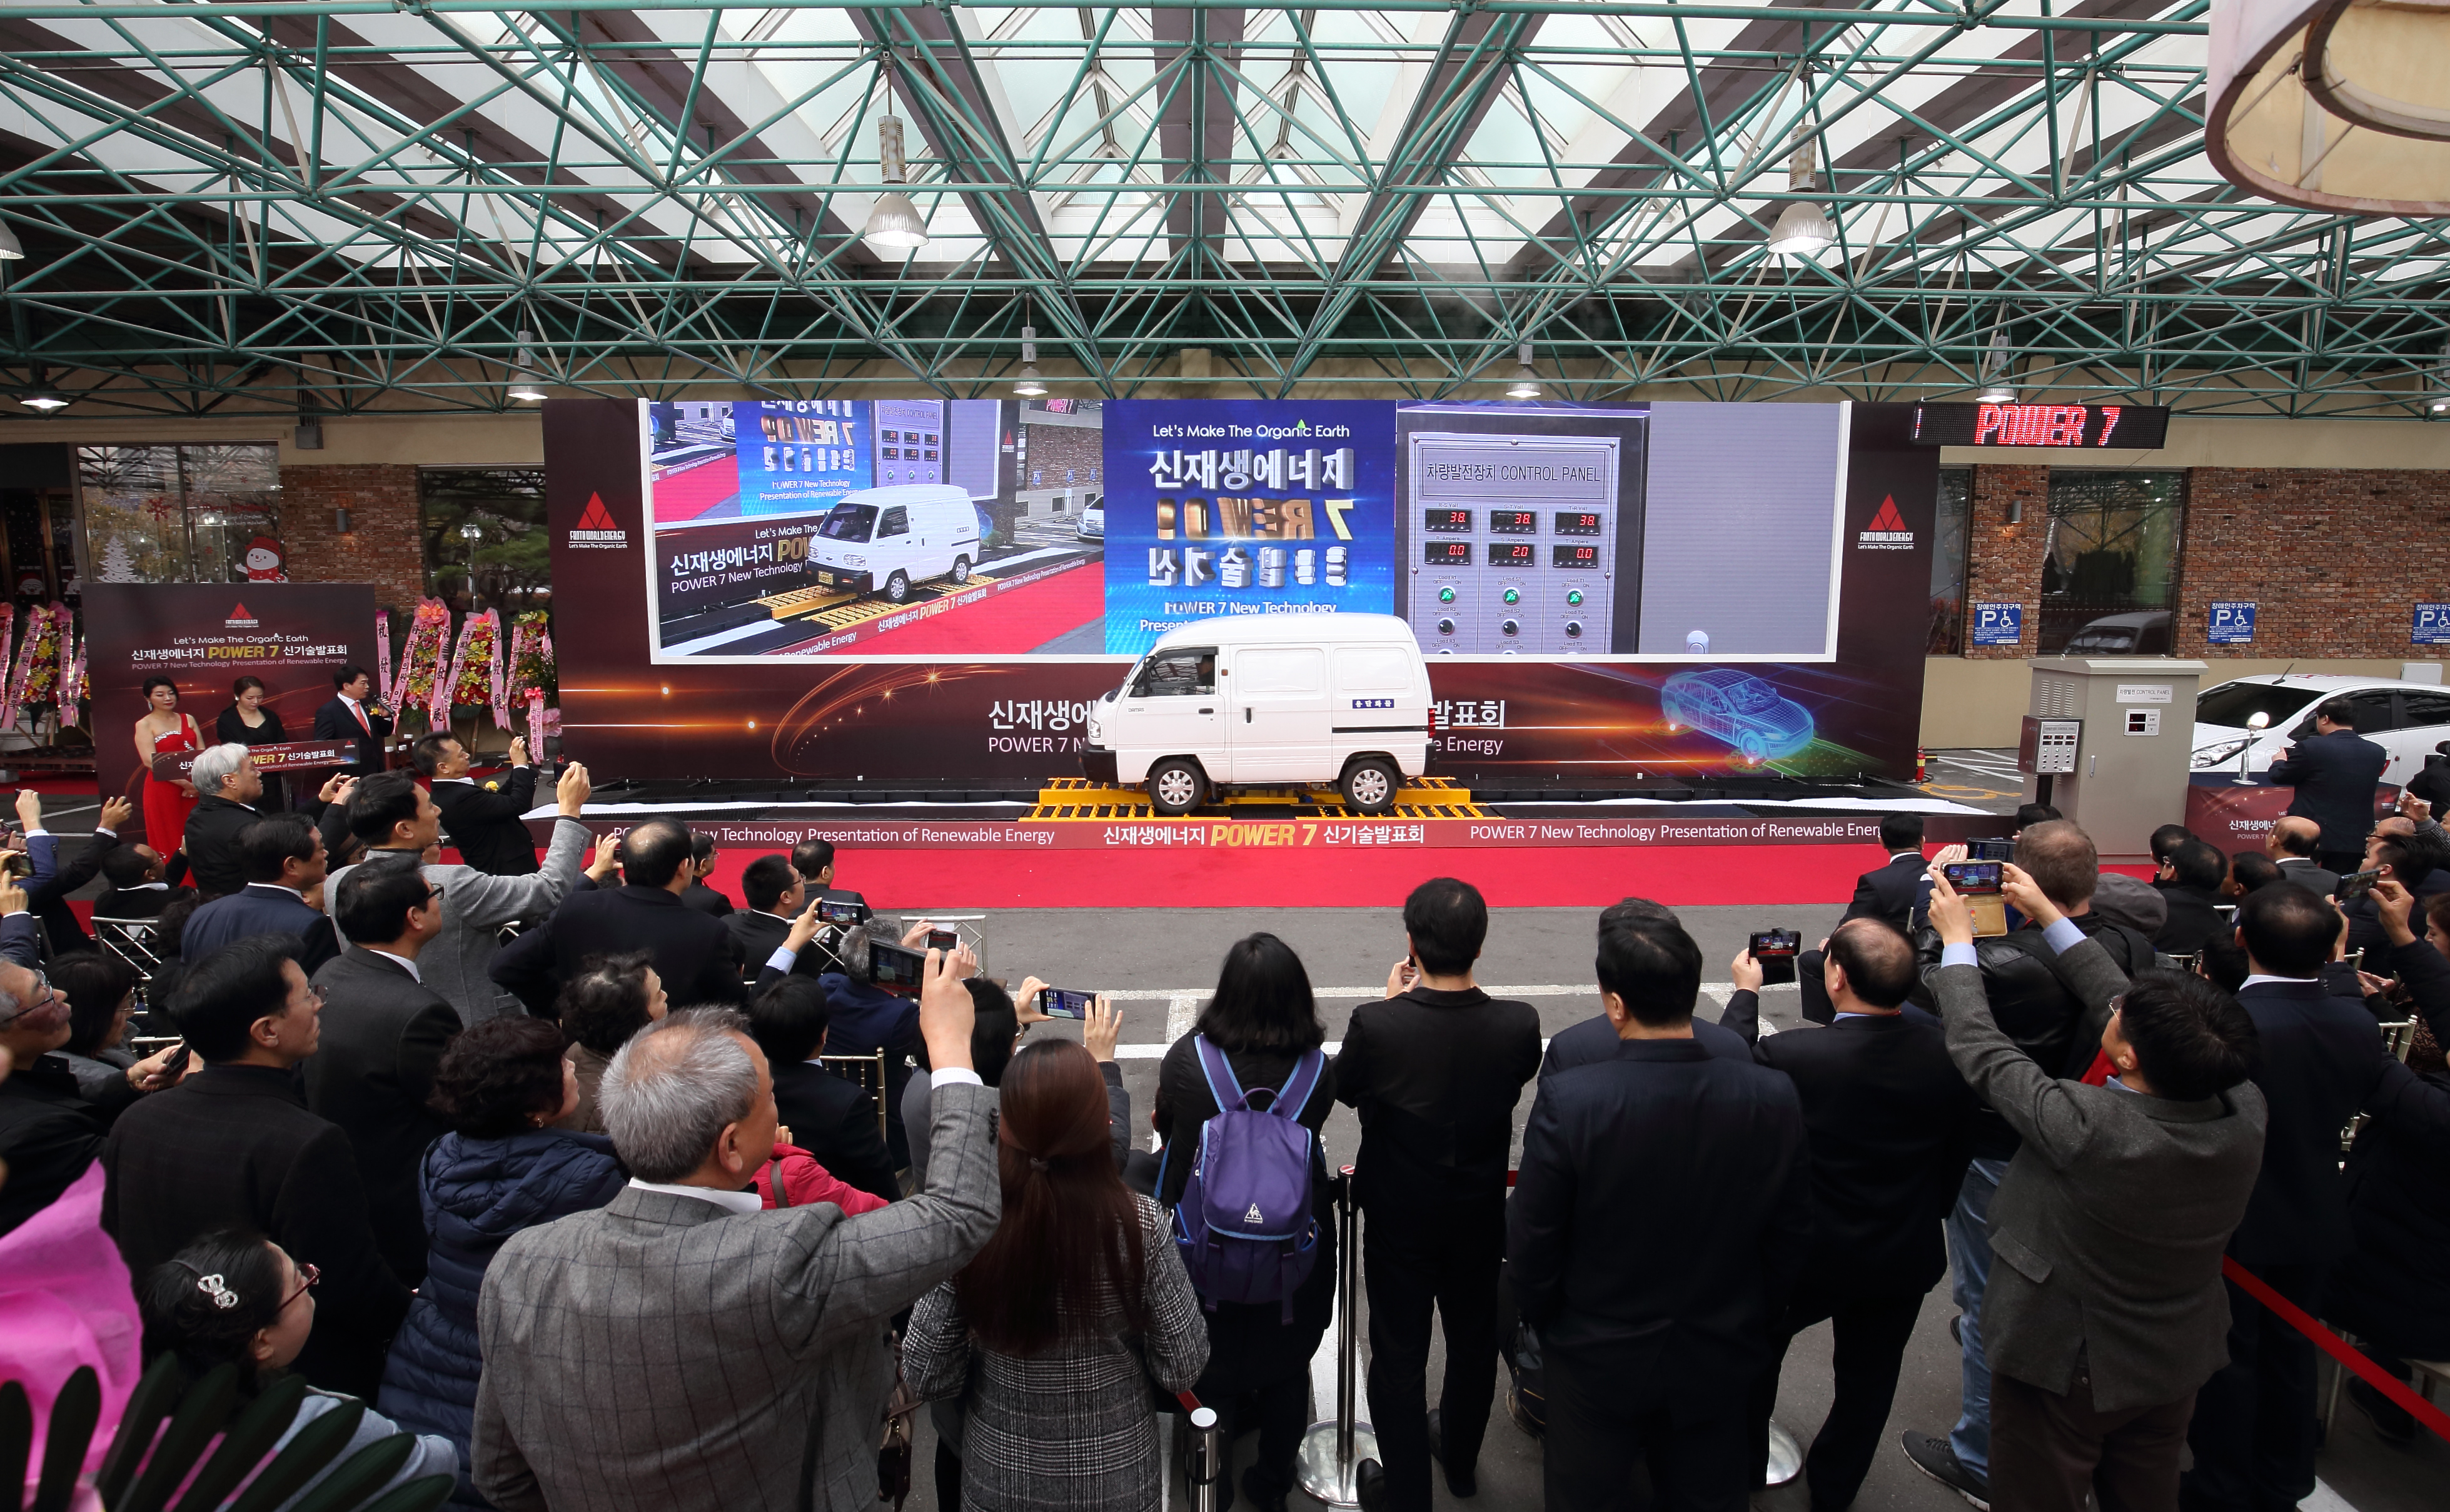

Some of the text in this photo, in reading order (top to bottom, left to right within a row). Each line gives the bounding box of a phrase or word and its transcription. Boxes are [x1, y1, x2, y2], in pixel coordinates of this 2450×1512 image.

[907, 408, 939, 420] CONTROL PANEL
[1153, 424, 1349, 440] Let's Make The Organic Earth
[1974, 404, 2121, 446] POWER 7
[1149, 448, 1354, 491] 신재생에너지
[1426, 463, 1601, 482] 차량발전장치 CONTROL PANEL
[819, 480, 850, 488] Technology
[760, 489, 842, 501] Presentation of Renewable
[755, 525, 818, 539] Let's Make The
[1513, 546, 1528, 557] 2.0
[670, 543, 773, 577] 신재생에너지
[672, 575, 717, 593] POWER
[718, 574, 726, 585] 7
[728, 570, 752, 583] New
[753, 561, 802, 578] Technology
[877, 609, 919, 632] 신재생에너지
[920, 598, 949, 620] POWER
[950, 597, 956, 610] 7
[1218, 602, 1227, 614] 7
[1229, 601, 1260, 614] New
[1263, 601, 1336, 614] Technology
[1981, 611, 1997, 627] P
[2216, 610, 2231, 626] P
[2420, 611, 2435, 627] P
[246, 635, 284, 643] Organic
[832, 632, 857, 647] Energy
[131, 645, 347, 660] 신재생에너지 POWER 7 신기술발표회
[454, 630, 471, 672] 국회의원
[989, 700, 1097, 730] 신재생에
[989, 737, 1053, 752] POWER
[1058, 737, 1067, 752] 7
[1447, 737, 1503, 755] Energy
[250, 749, 335, 764] WER 7 신기술발표회
[721, 827, 1055, 845] Technology Presentation of Renewable Energy
[1104, 824, 1424, 846] 신재생에너지 POWER 7 신기술발표회
[1471, 823, 1880, 841] POWER 7 New Technology Presentation of Renewable Ener
